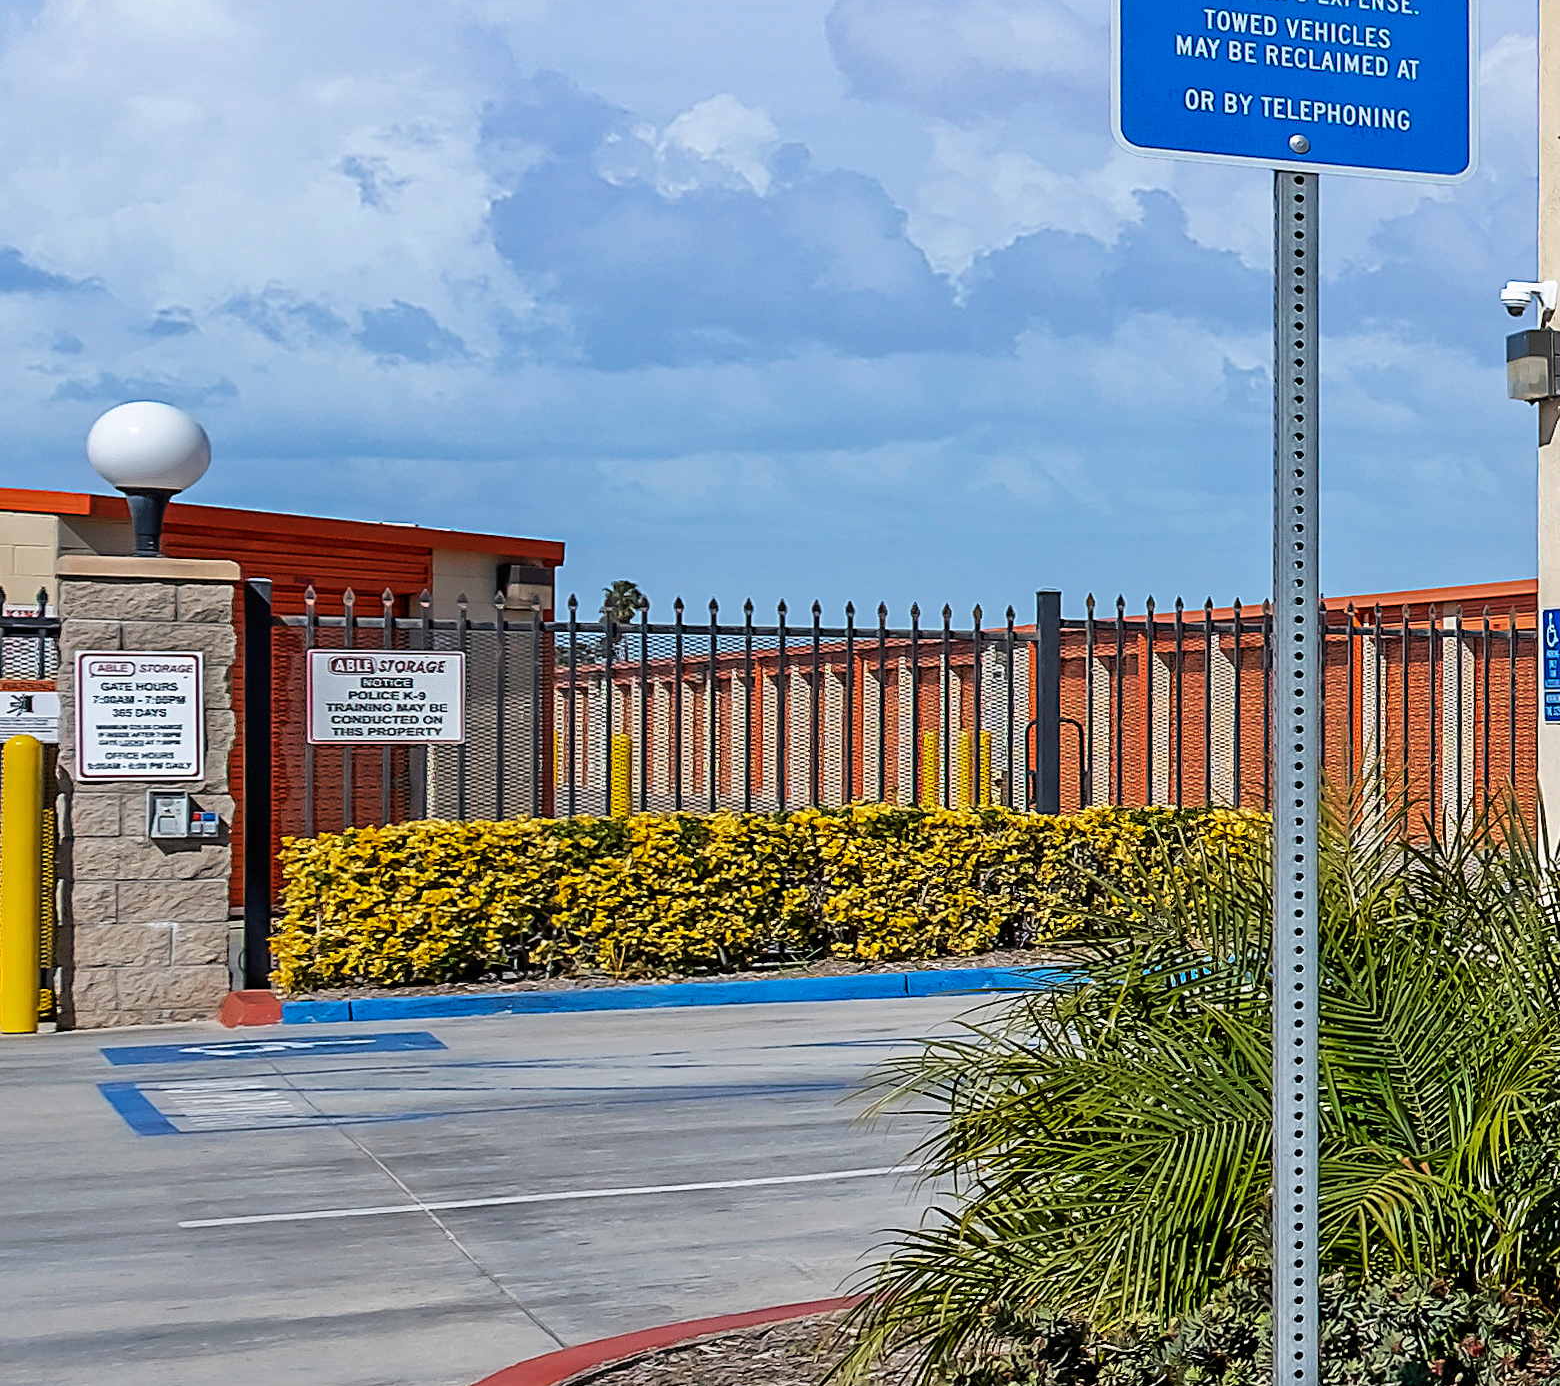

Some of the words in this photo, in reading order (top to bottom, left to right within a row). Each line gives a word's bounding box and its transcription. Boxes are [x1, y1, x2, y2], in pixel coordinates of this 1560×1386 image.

[1204, 9, 1277, 37] TOWED
[1286, 19, 1390, 48] VEHICLES
[1175, 34, 1220, 59] MAY
[1228, 41, 1256, 64] BE
[1266, 45, 1388, 77] RECLAIMED
[1397, 58, 1419, 81] AT
[1185, 88, 1215, 112] OR
[1225, 93, 1253, 115] BY
[1261, 95, 1411, 131] TELEPHONING
[97, 664, 128, 673] ABLE
[139, 664, 194, 673] STORAGE
[334, 659, 373, 672] ABLE
[377, 660, 446, 674] STORAGE
[100, 682, 133, 691] GATE
[135, 682, 179, 691] HOURS
[362, 678, 412, 687] NOTICE
[349, 691, 400, 700] POLICE
[403, 691, 426, 700] K-9
[326, 703, 393, 712] TRAINING
[396, 703, 425, 712] MAY
[429, 704, 448, 712] BE
[112, 708, 133, 717] 365
[135, 708, 167, 717] DAYS
[331, 715, 419, 724] CONDUCTED
[423, 715, 443, 724] ON
[331, 727, 363, 736] THIS
[367, 727, 442, 736] PROPERTY
